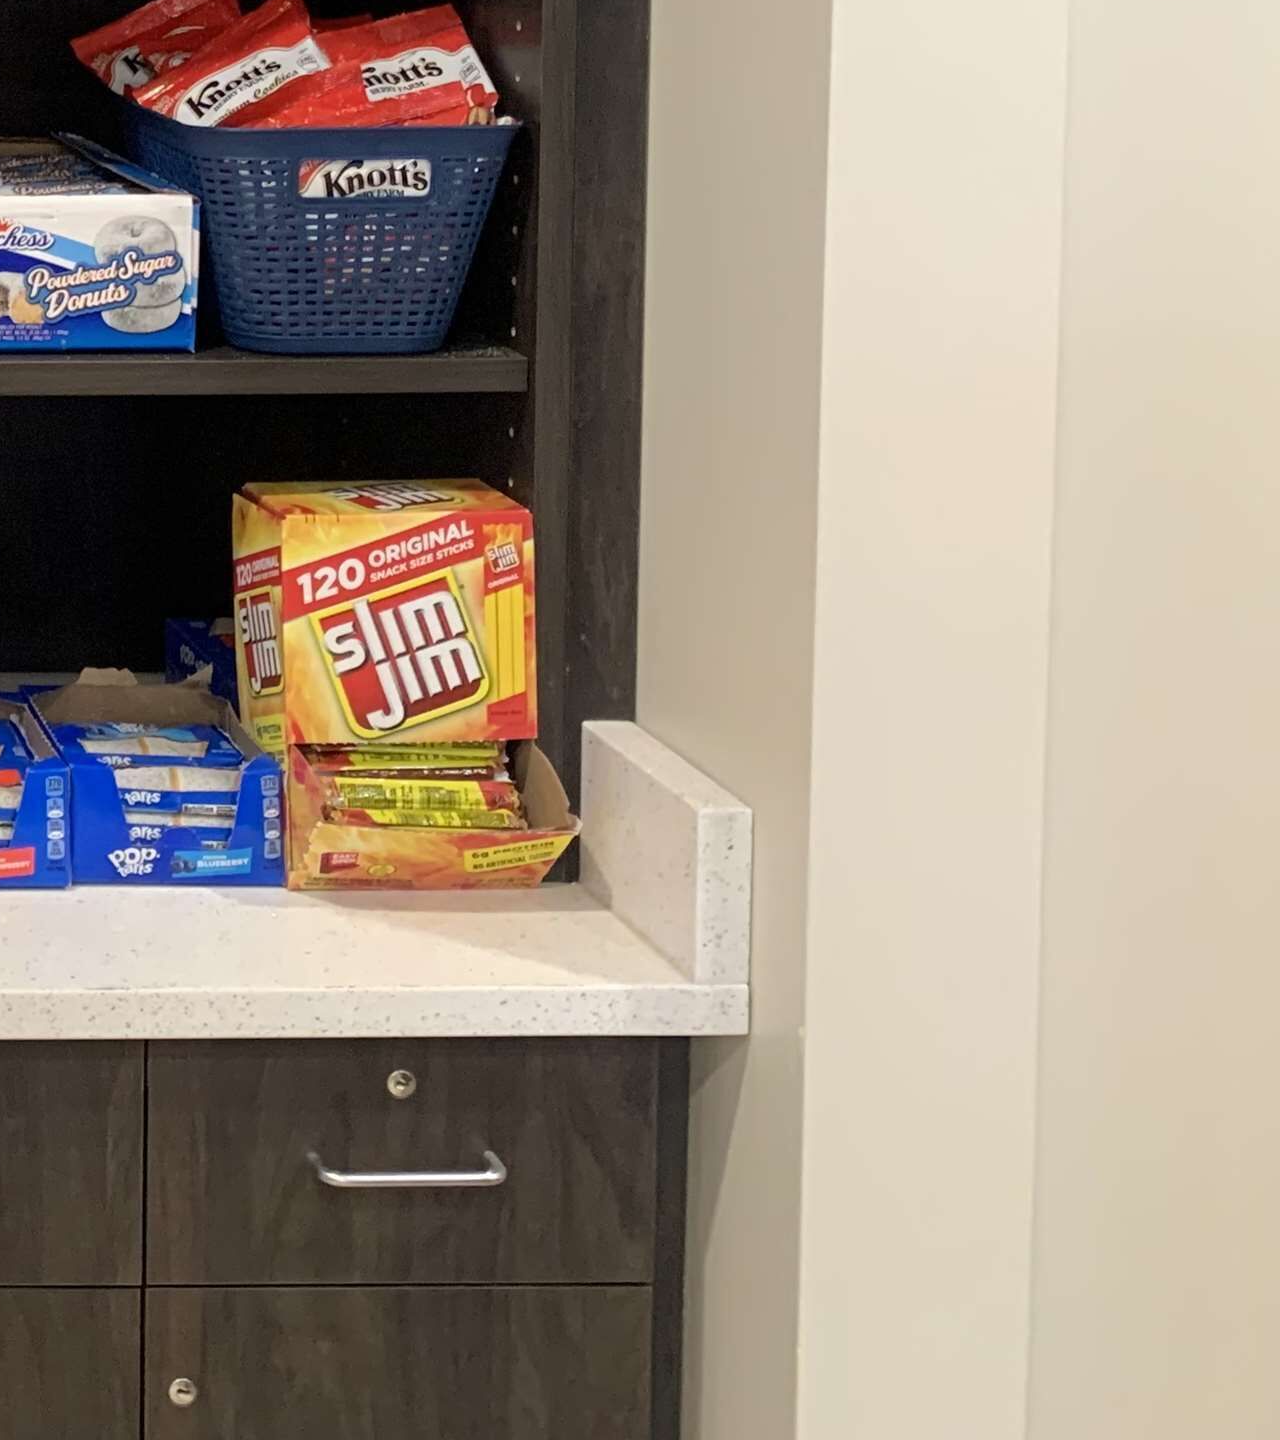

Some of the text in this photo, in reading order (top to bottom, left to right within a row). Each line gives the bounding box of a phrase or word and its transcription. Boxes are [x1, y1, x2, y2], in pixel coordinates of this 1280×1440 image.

[186, 59, 283, 120] Knott's
[323, 160, 429, 197] Knott's
[28, 251, 176, 298] Powdered Sugar
[44, 284, 129, 318] Donuts
[296, 520, 475, 605] 120 ORIGINAL
[369, 538, 476, 583] SNACK SIZE STICKS
[239, 595, 277, 646] slim
[322, 590, 467, 676] slim
[250, 640, 282, 694] jim
[365, 636, 482, 731] jim
[124, 791, 162, 805] tarts
[107, 847, 160, 869] Pop
[119, 862, 153, 877] tarts
[196, 857, 250, 869] BLUEBERRY
